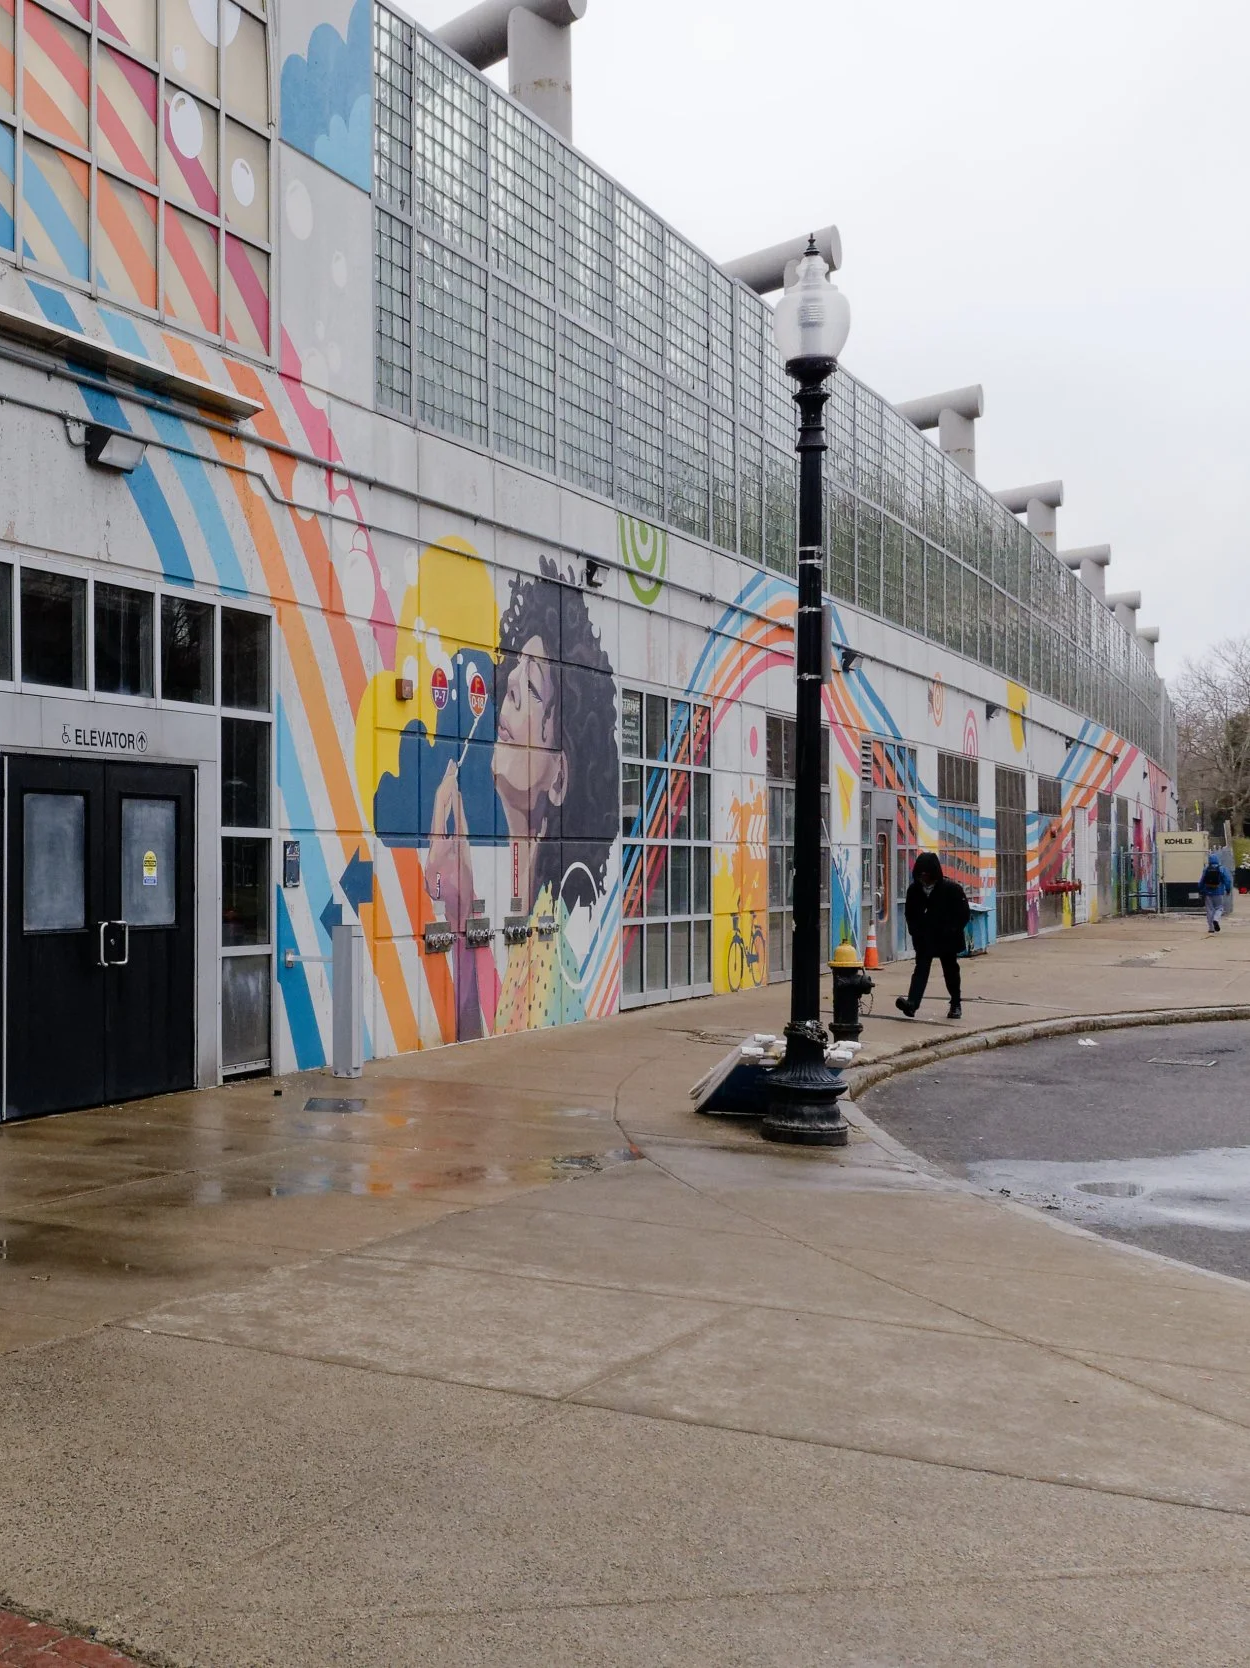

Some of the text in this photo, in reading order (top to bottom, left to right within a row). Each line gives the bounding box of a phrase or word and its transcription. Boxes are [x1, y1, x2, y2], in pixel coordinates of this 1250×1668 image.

[436, 670, 443, 687] F
[475, 677, 481, 693] F
[434, 689, 446, 703] P-7
[75, 728, 135, 750] ELEVATOR
